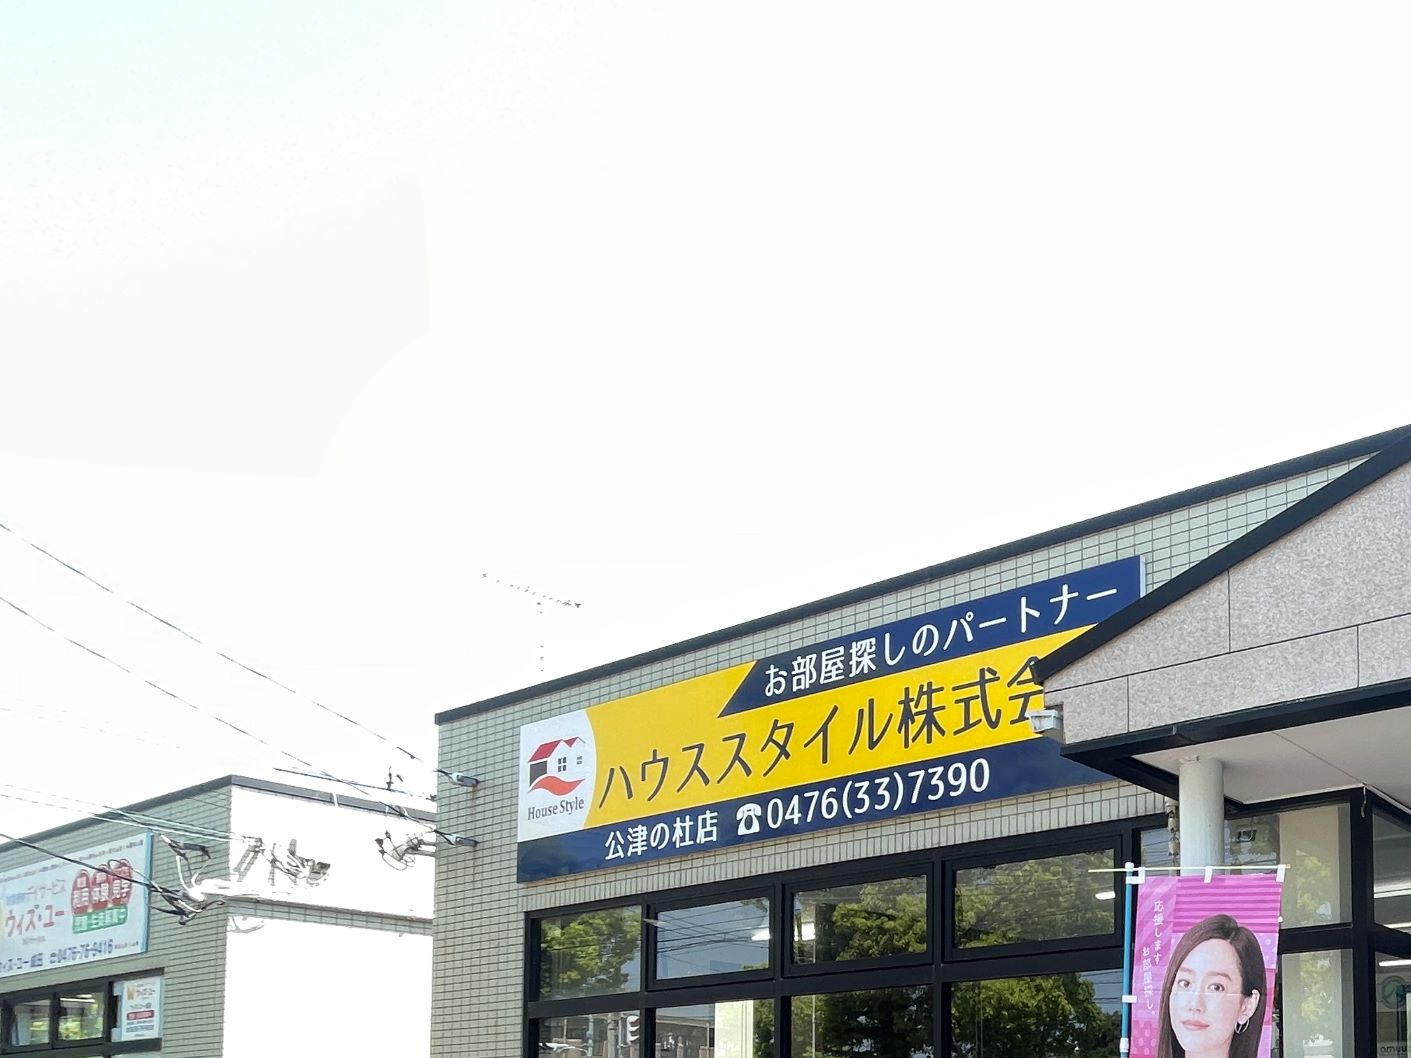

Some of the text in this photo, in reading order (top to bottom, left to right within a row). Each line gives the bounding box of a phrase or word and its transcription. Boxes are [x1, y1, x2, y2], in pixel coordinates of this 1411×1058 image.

[765, 583, 1118, 698] お部屋探しのパートナー
[528, 796, 585, 821] House Style
[766, 758, 991, 830] 0476(33)7390
[603, 809, 719, 862] 公津の杜店
